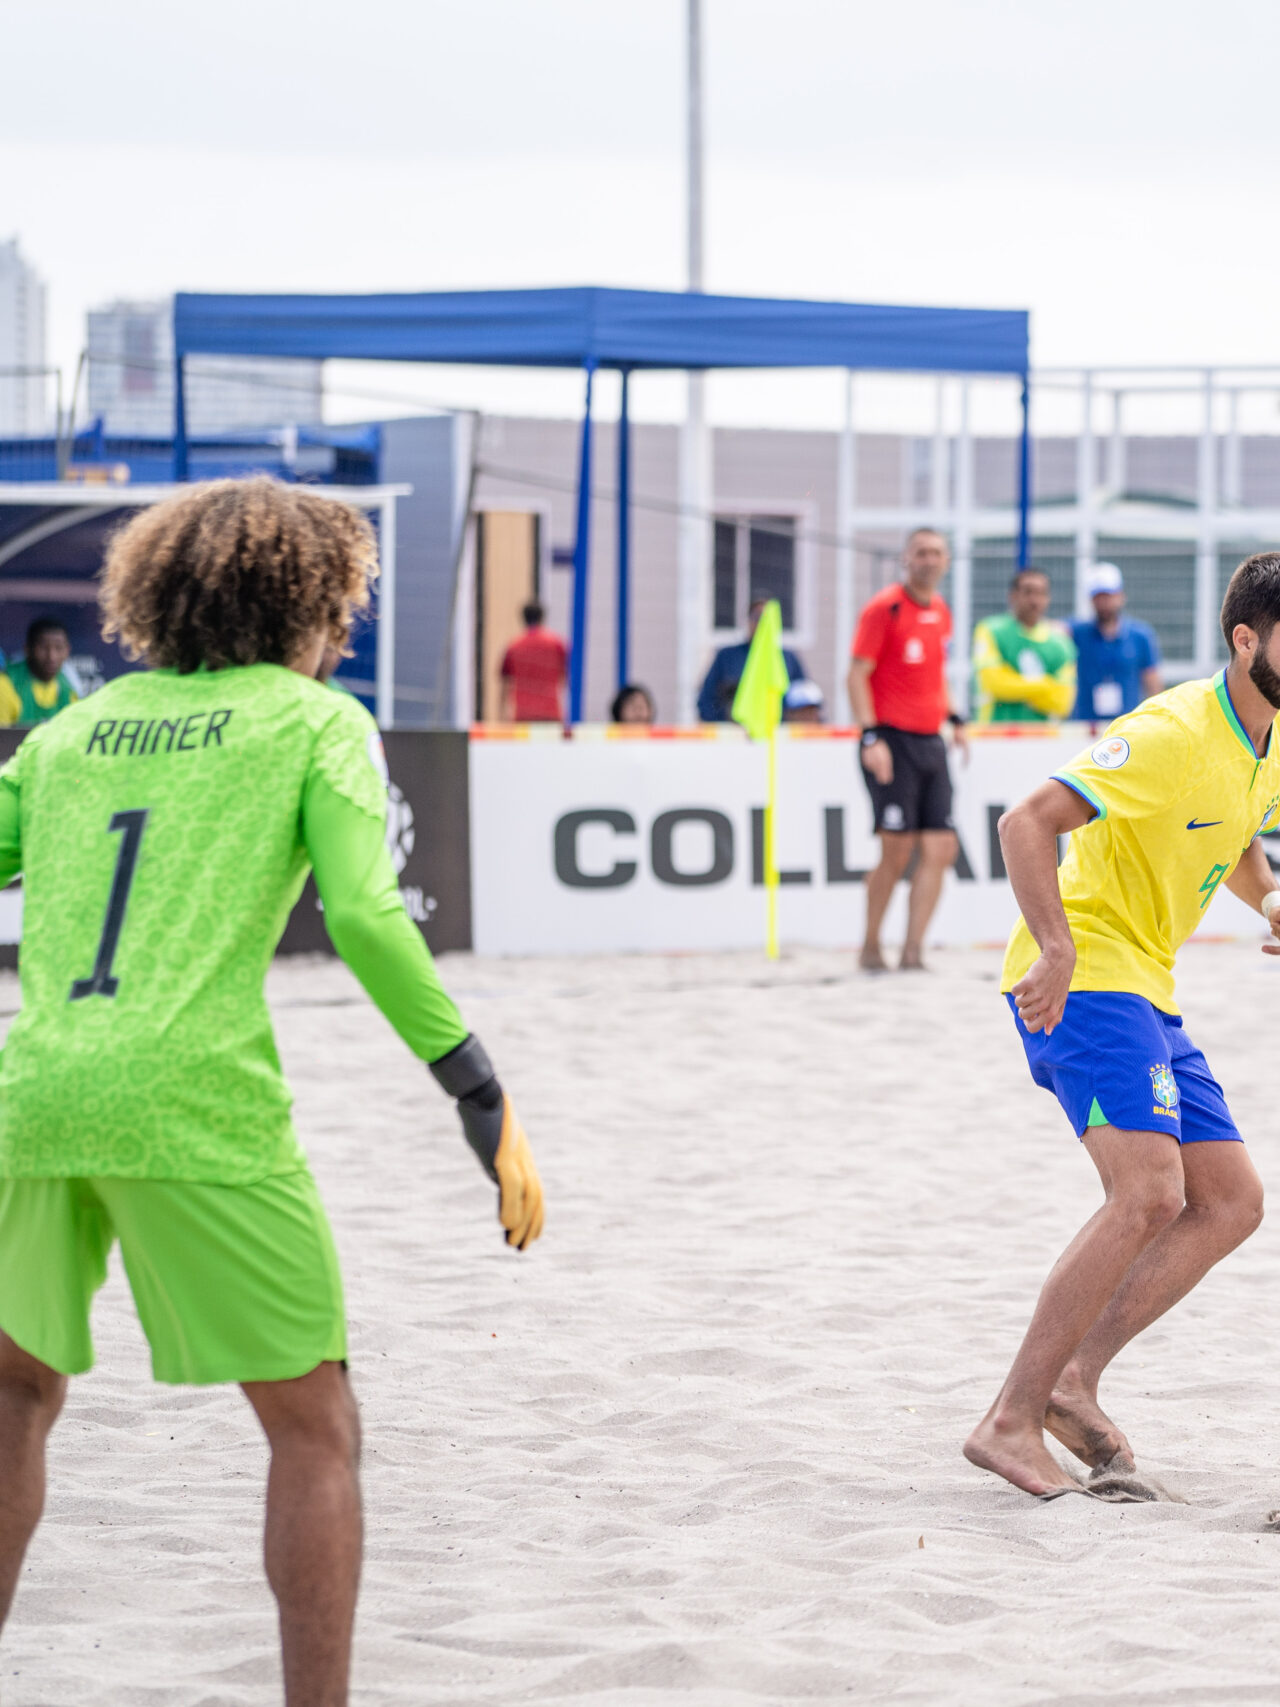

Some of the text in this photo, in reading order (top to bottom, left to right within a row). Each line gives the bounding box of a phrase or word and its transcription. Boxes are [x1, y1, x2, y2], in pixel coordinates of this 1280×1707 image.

[86, 709, 233, 755] RAINER
[69, 808, 151, 1000] 1
[1198, 863, 1230, 909] 9
